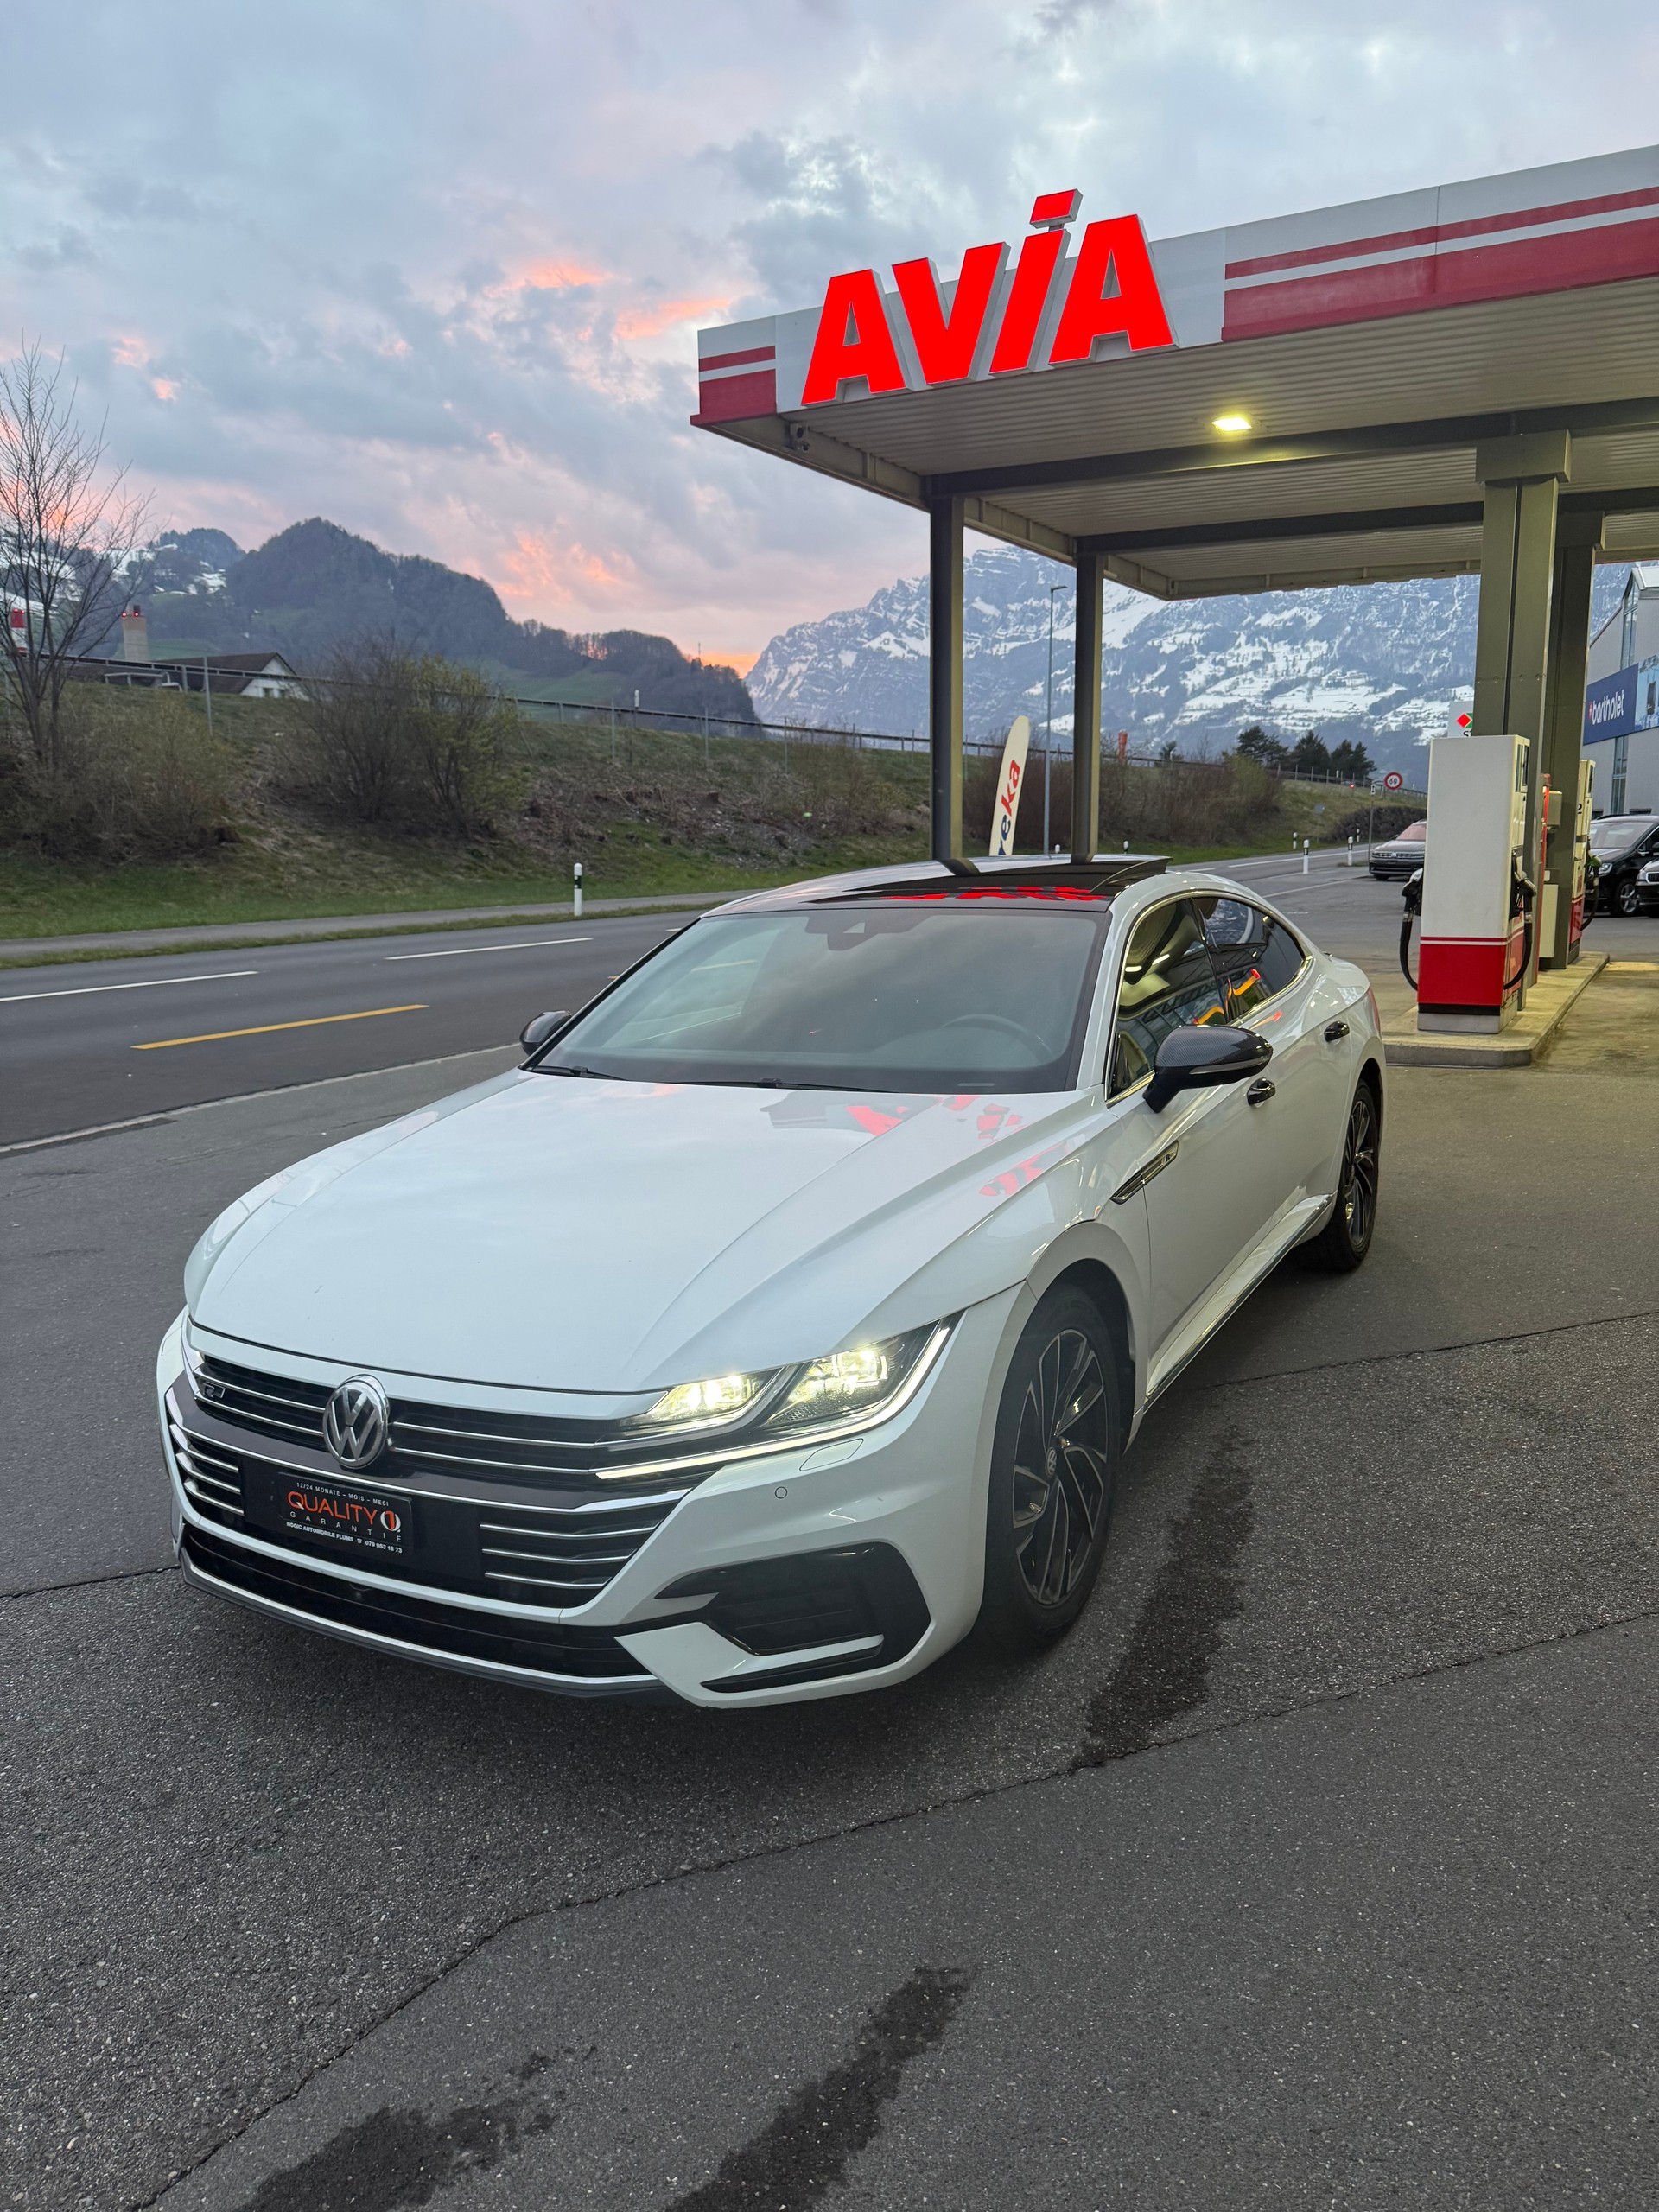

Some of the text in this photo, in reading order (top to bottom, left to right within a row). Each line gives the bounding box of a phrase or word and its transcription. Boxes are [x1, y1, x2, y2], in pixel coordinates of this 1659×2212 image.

[1592, 689, 1624, 725] bartholet
[1577, 803, 1583, 815] 2
[287, 1491, 378, 1525] QUALITY
[296, 1482, 313, 1491] 12/24
[315, 1486, 340, 1497] MONATE
[348, 1493, 365, 1502] MOIS
[372, 1498, 389, 1507] MESI
[289, 1511, 402, 1542] GARANTIE
[302, 1526, 335, 1538] AUTOMOBILE
